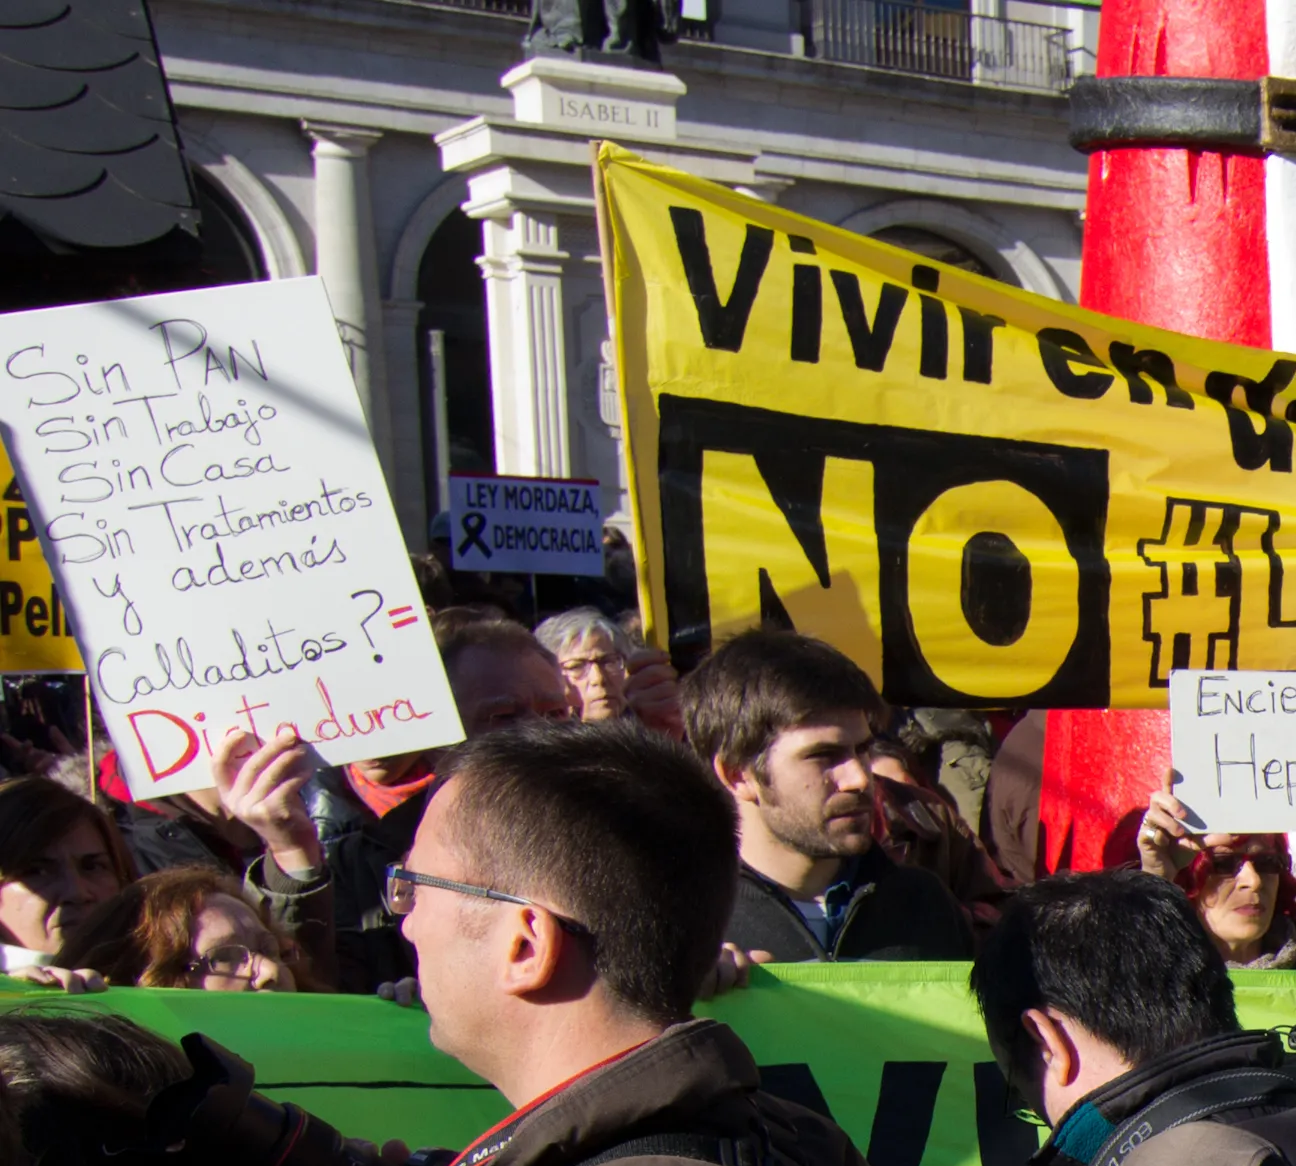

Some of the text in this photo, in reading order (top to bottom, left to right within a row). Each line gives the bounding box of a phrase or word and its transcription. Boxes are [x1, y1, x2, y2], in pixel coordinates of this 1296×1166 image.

[559, 97, 660, 129] ISABEL II
[668, 205, 1007, 385] Vivir
[1035, 325, 1196, 410] en
[6, 318, 269, 409] Sin PAN
[35, 391, 278, 454] Sin Trabajo
[58, 458, 154, 504] Sin
[160, 443, 292, 488] Casa
[466, 483, 599, 519] LEY MORDAZA,
[46, 479, 373, 565] Sin Tratamientos
[493, 523, 599, 556] DEMOCRACIA.
[92, 536, 347, 636] y además
[702, 448, 1080, 698] NO
[1119, 1120, 1153, 1156] EOS
